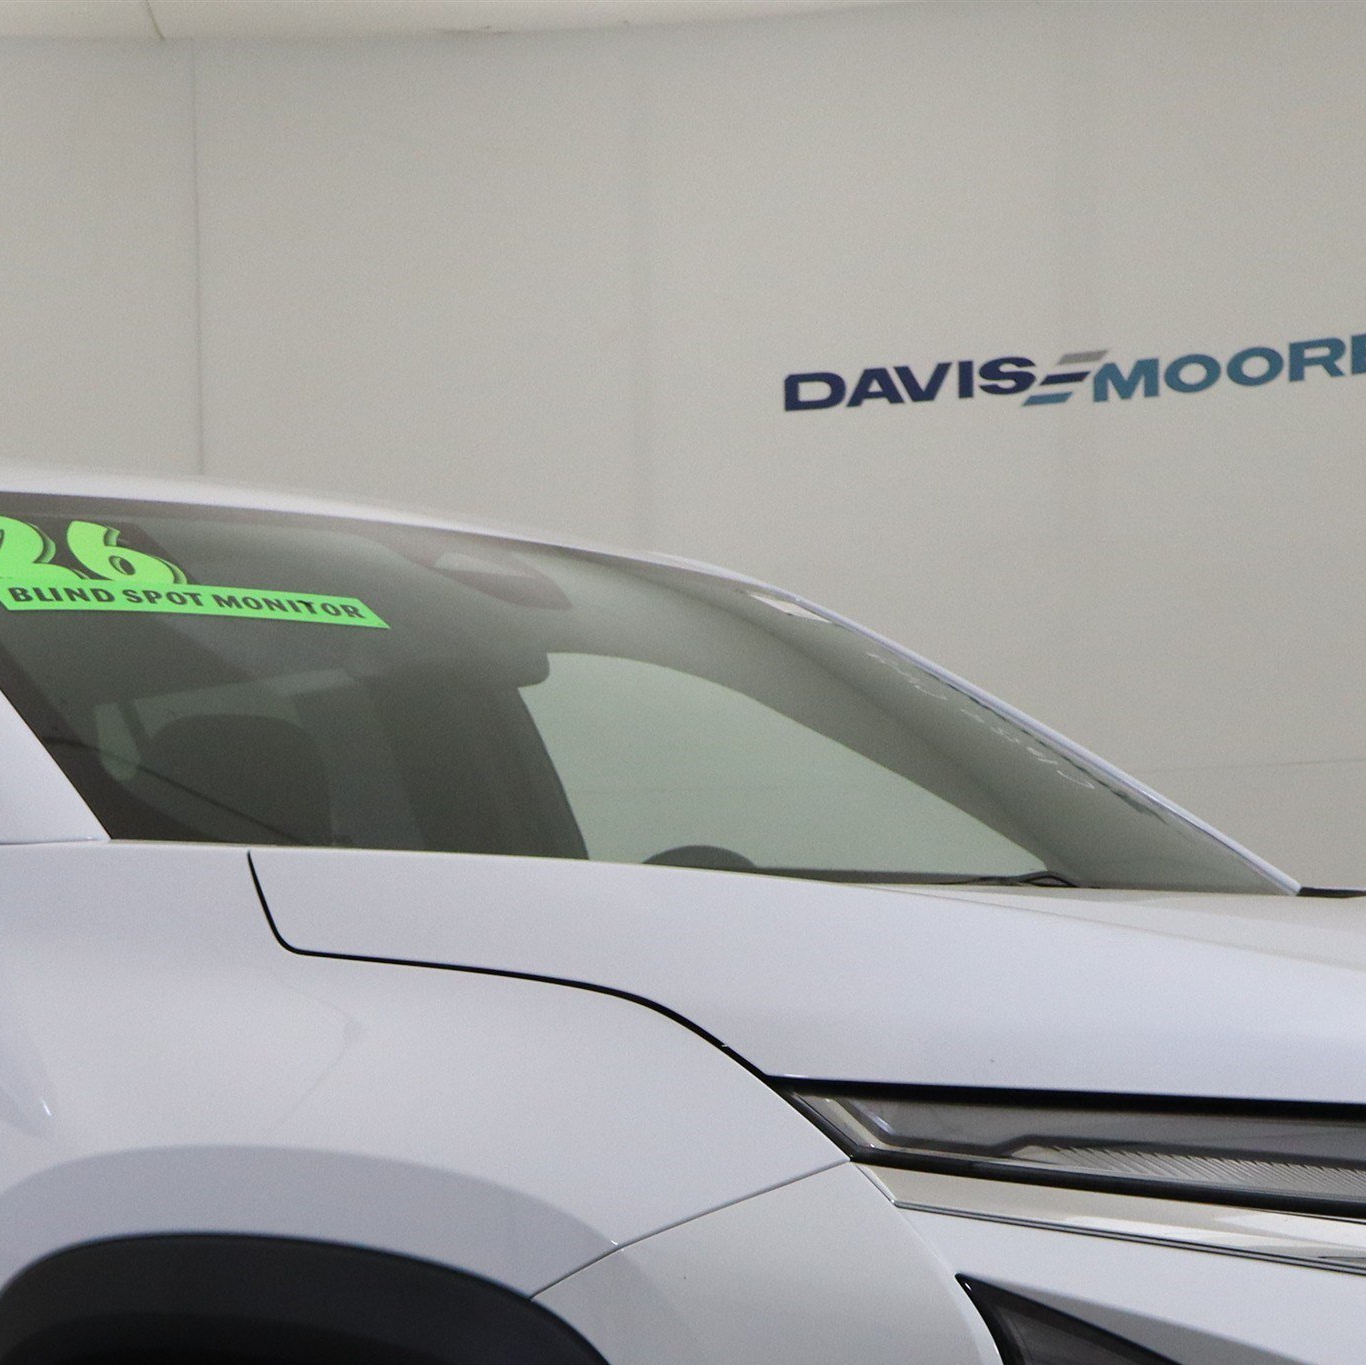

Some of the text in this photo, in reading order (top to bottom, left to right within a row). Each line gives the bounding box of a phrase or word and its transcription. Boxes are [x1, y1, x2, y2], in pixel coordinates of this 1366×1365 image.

[783, 356, 1037, 412] DAVIS
[8, 587, 367, 619] BLIND SPOT MONITOR
